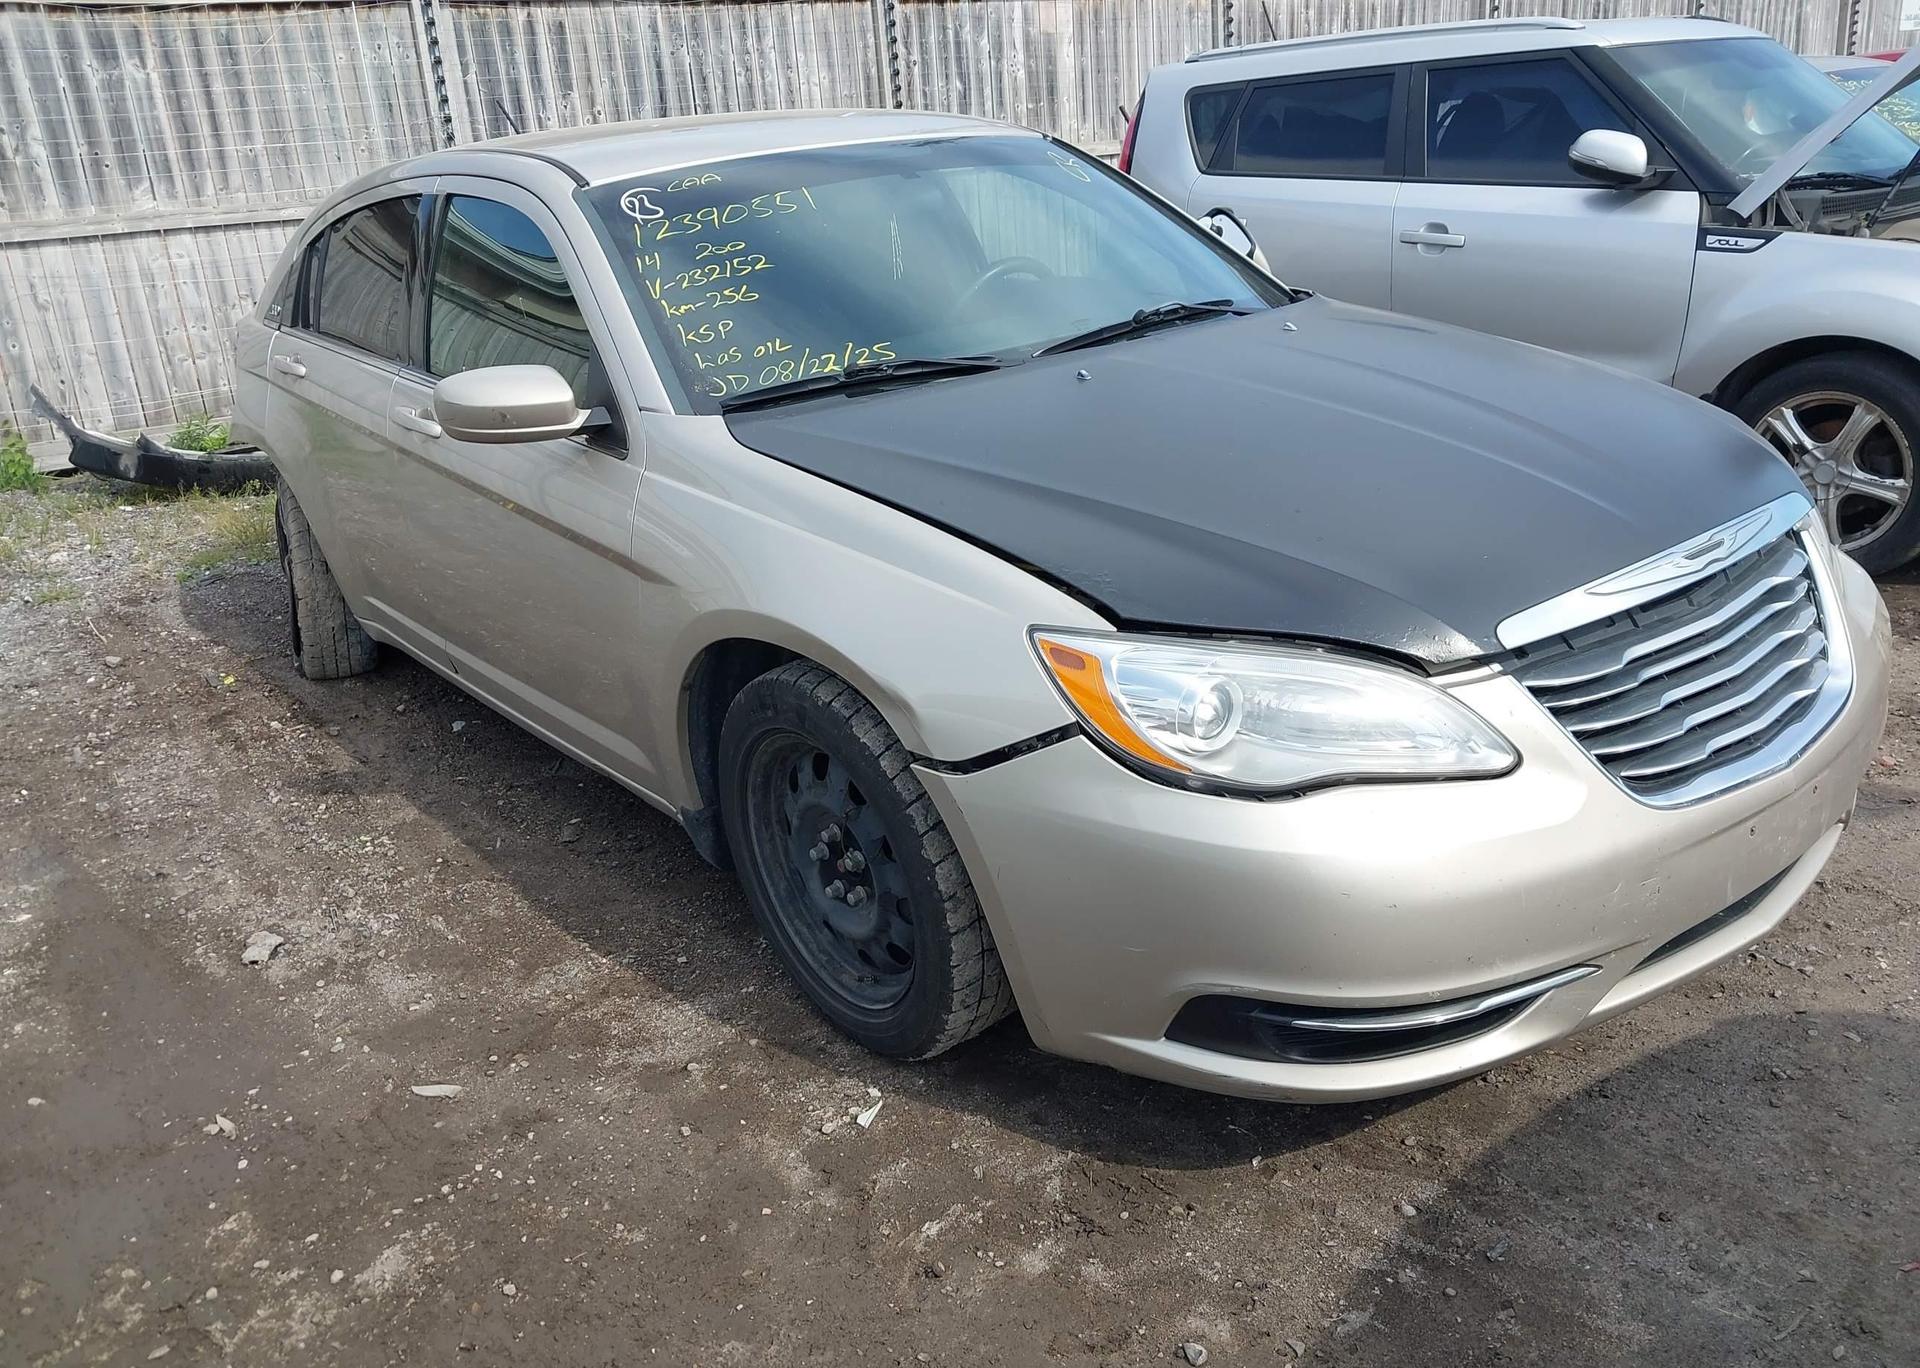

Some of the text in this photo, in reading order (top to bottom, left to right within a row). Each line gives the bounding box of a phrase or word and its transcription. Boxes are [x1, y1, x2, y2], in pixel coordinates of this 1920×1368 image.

[634, 186, 817, 249] 12390551
[636, 241, 746, 273] 14 200
[709, 374, 750, 397] JD
